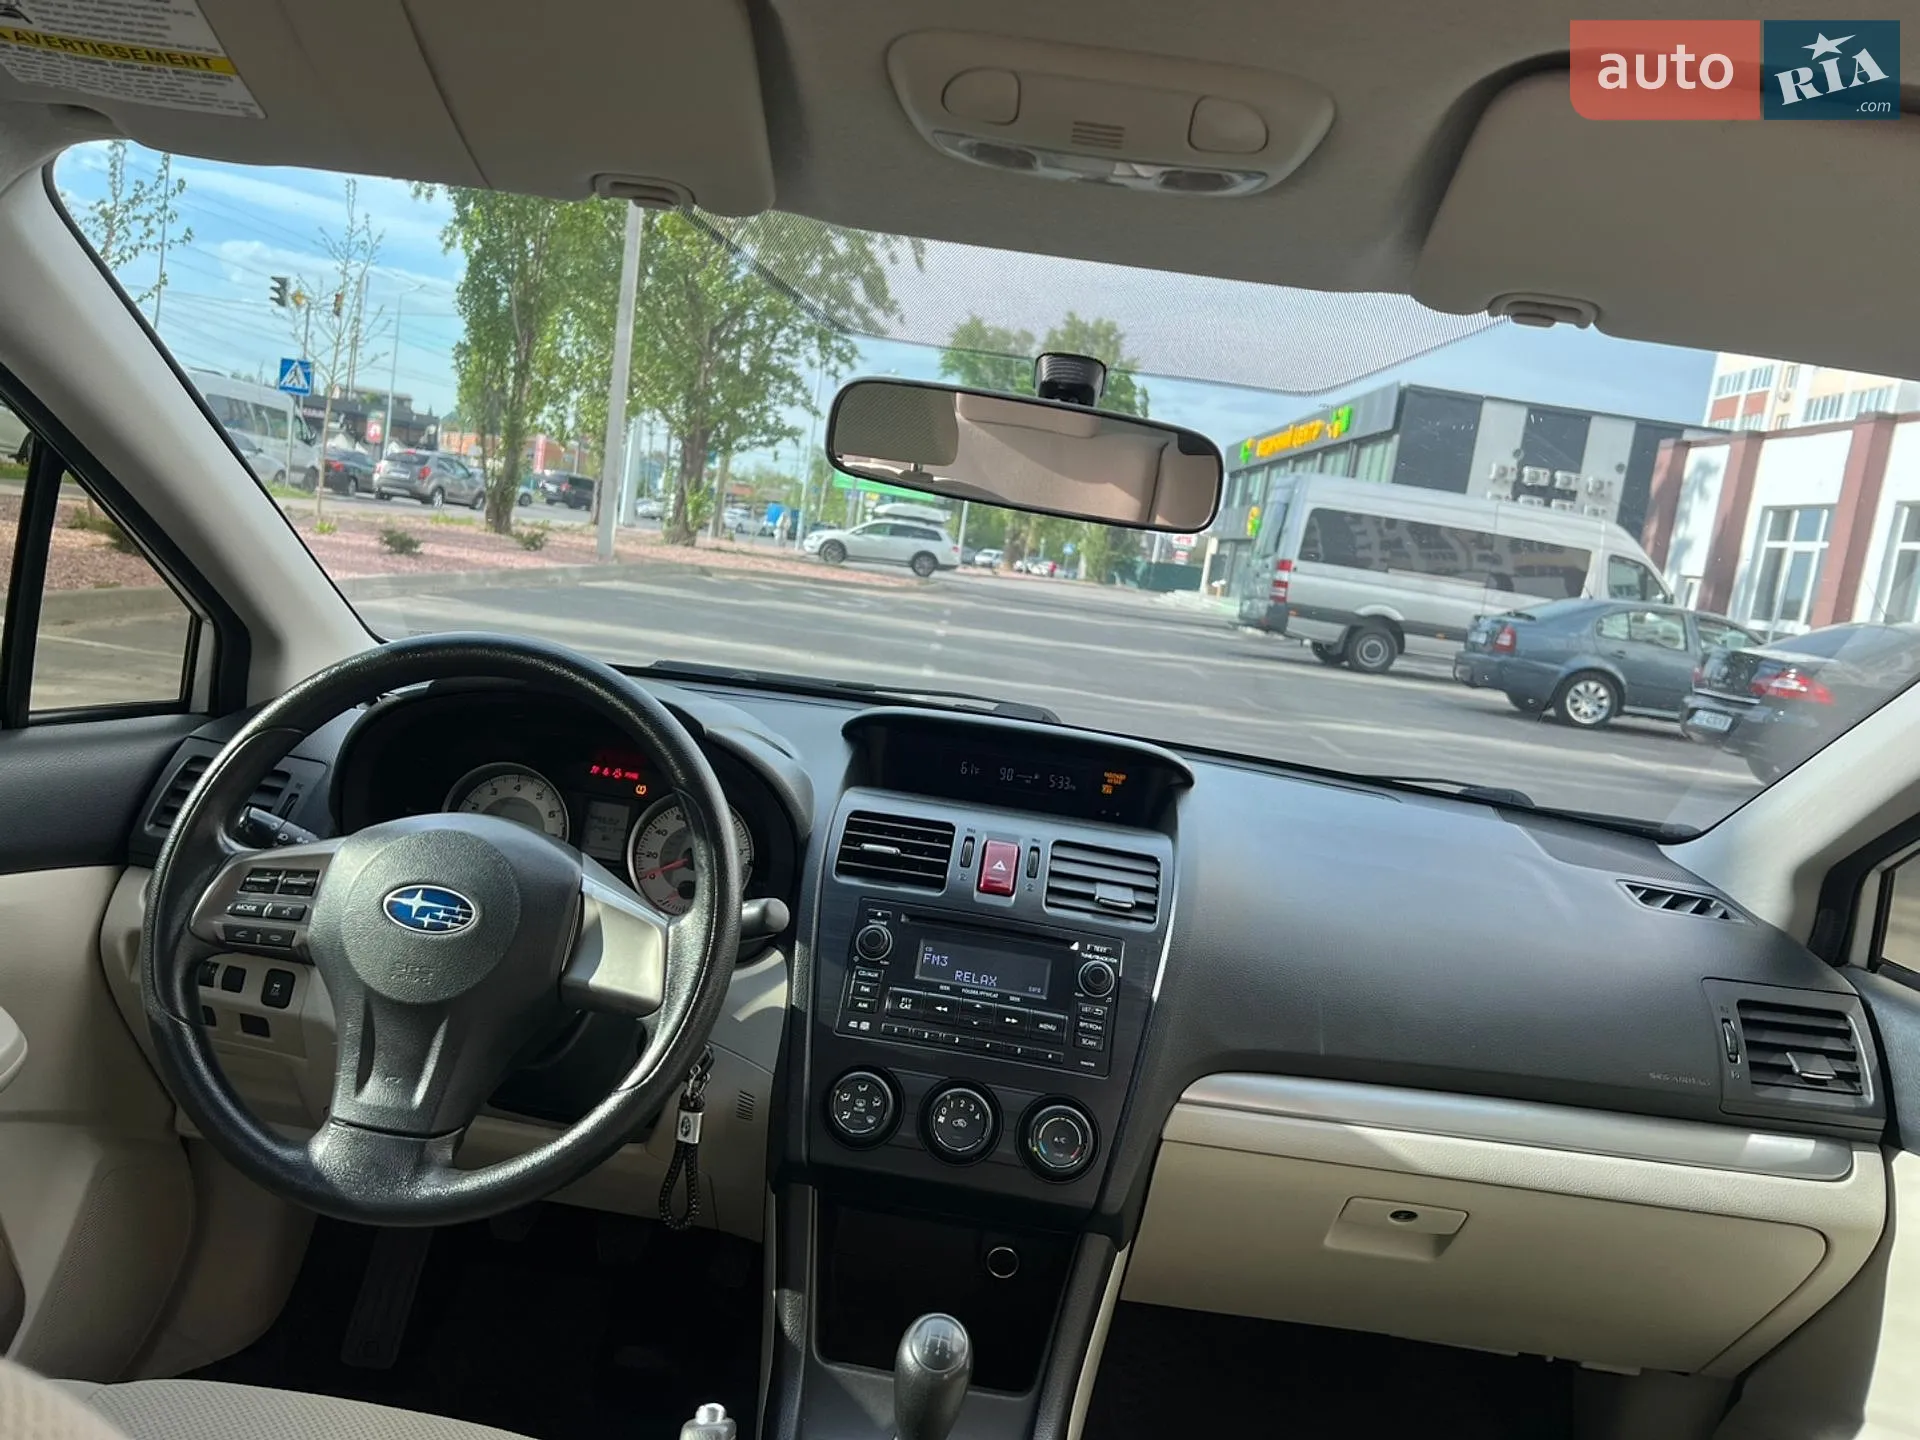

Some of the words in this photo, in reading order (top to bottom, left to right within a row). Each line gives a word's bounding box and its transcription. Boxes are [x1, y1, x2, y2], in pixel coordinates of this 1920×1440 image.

[13, 31, 212, 70] AVERTISSEMENT
[922, 953, 948, 967] FM3
[954, 970, 998, 987] RELAX
